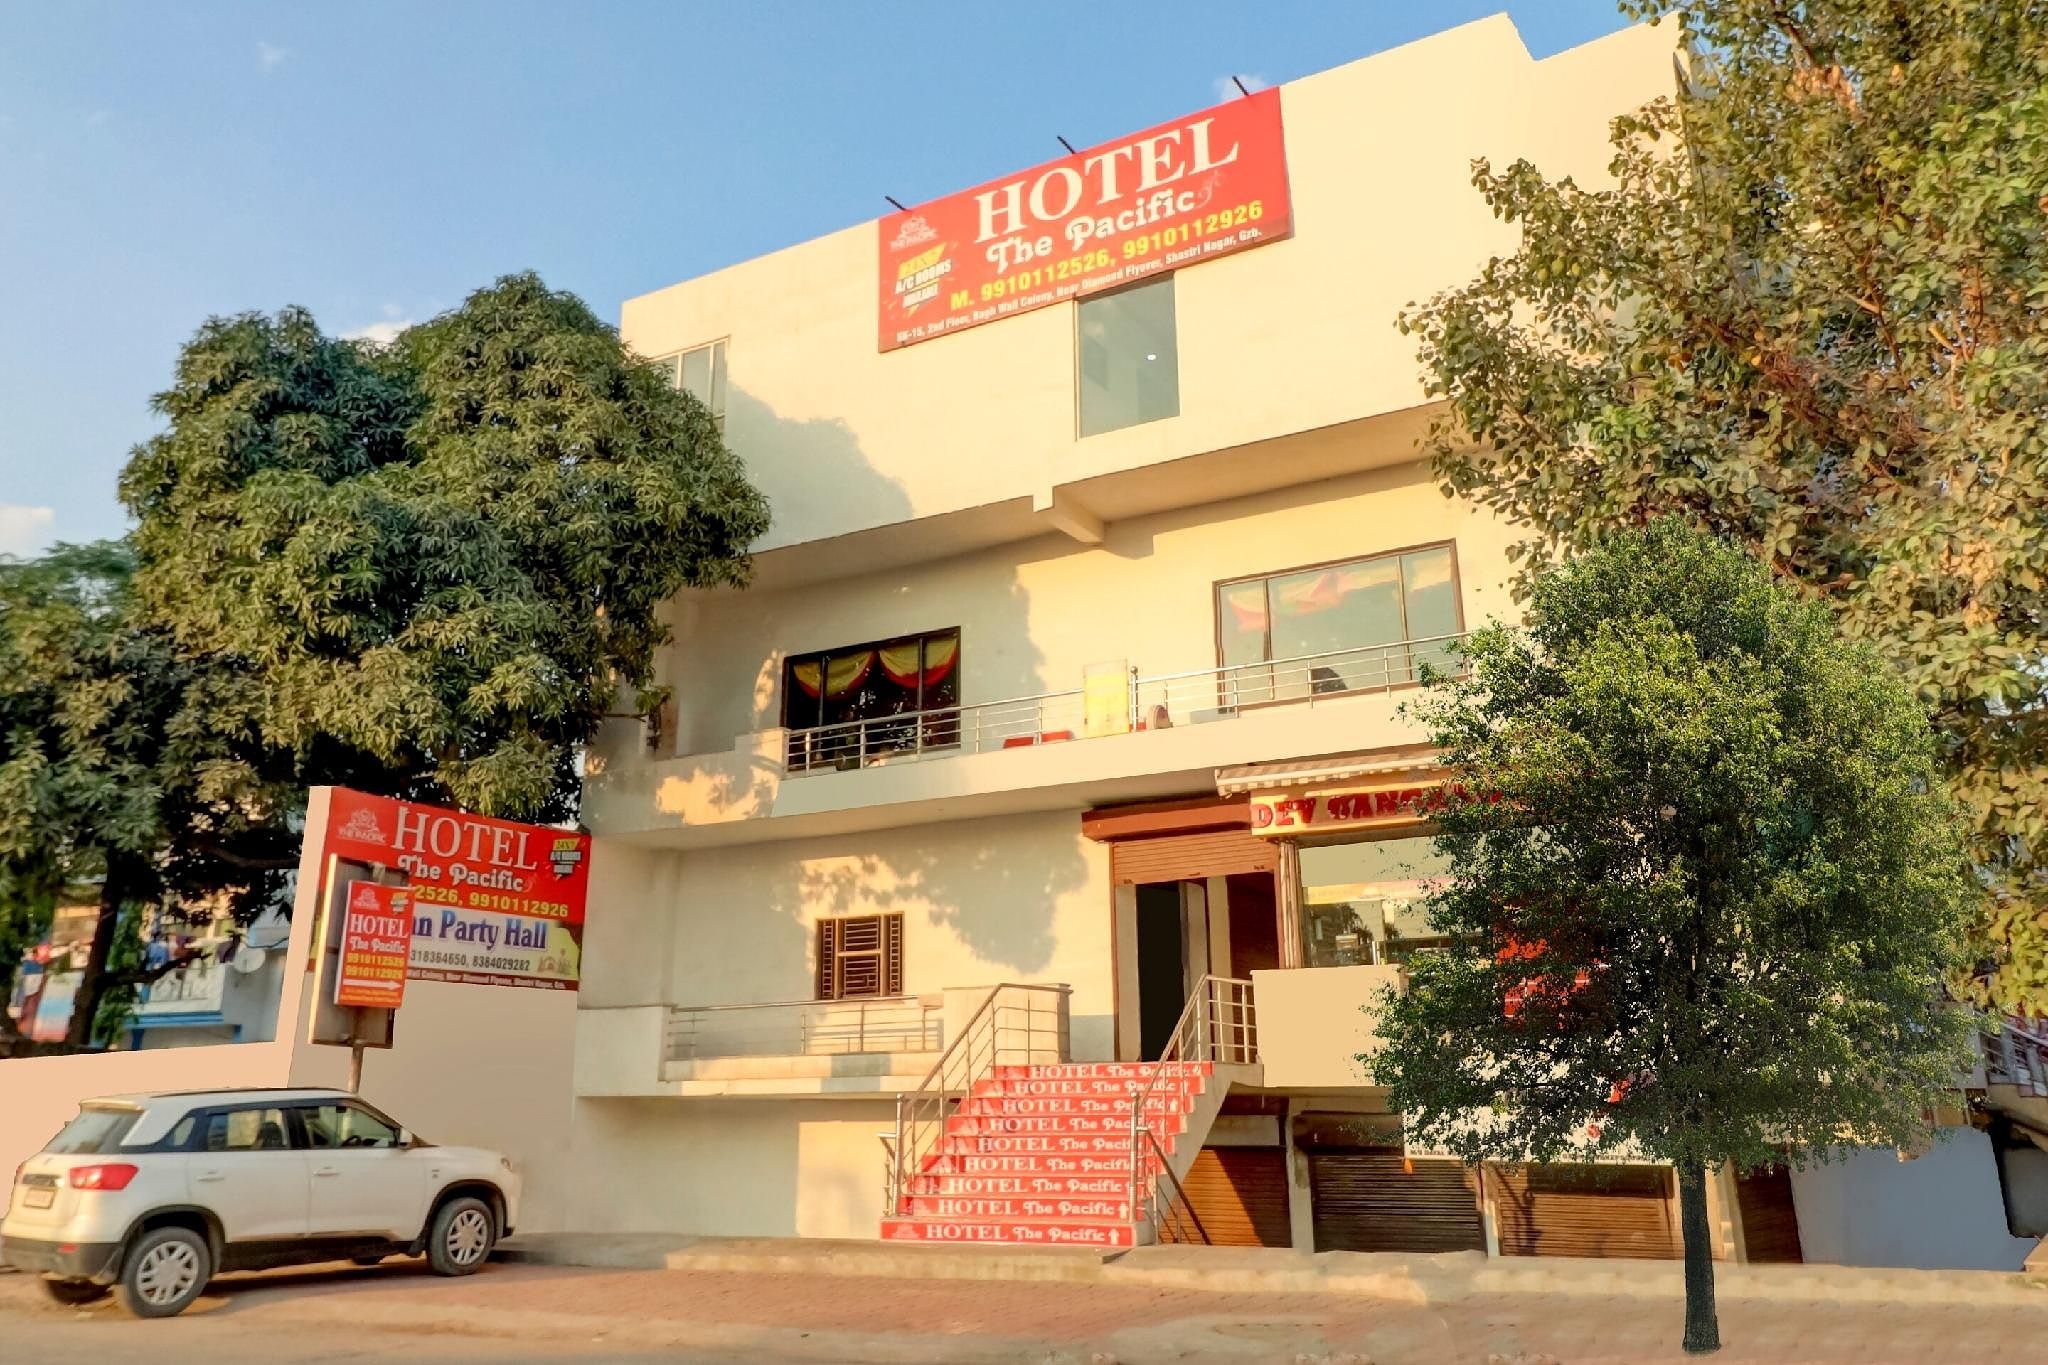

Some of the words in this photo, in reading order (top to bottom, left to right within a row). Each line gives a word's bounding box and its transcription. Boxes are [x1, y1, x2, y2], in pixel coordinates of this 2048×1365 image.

[973, 117, 1240, 244] HOTEL
[986, 236, 1053, 274] The
[1064, 188, 1195, 252] Pacific
[950, 288, 976, 311] M.
[981, 247, 1117, 302] 9910112526,
[1122, 199, 1264, 260] 9910112926
[1165, 244, 1200, 266] Shastri
[389, 805, 539, 871] HOTEL
[397, 853, 442, 880] The
[449, 861, 525, 893] Pacific
[469, 891, 569, 918] 9910112926
[349, 912, 410, 939] HOTEL
[438, 909, 500, 951] Party
[503, 917, 547, 950] Hall
[349, 935, 369, 950] The
[1030, 1063, 1105, 1079] HOTEL
[1107, 1064, 1135, 1077] The
[1013, 1079, 1089, 1095] HOTEL
[1091, 1078, 1121, 1093] The
[1002, 1098, 1078, 1114] HOTEL
[1080, 1099, 1109, 1113] The
[989, 1117, 1066, 1132] HOTEL
[1069, 1117, 1098, 1131] The
[977, 1136, 1056, 1152] HOTEL
[1059, 1137, 1089, 1151] The
[964, 1156, 1043, 1172] HOTEL
[1047, 1158, 1076, 1171] The
[949, 1177, 1029, 1194] HOTEL
[1032, 1178, 1063, 1193] The
[1067, 1178, 1122, 1194] Pacific
[938, 1199, 1020, 1216] HOTEL
[1022, 1200, 1054, 1215] The
[1057, 1201, 1115, 1216] Pacific
[926, 1223, 1009, 1241] HOTEL
[1012, 1226, 1043, 1242] The
[1049, 1226, 1105, 1242] Pacific
